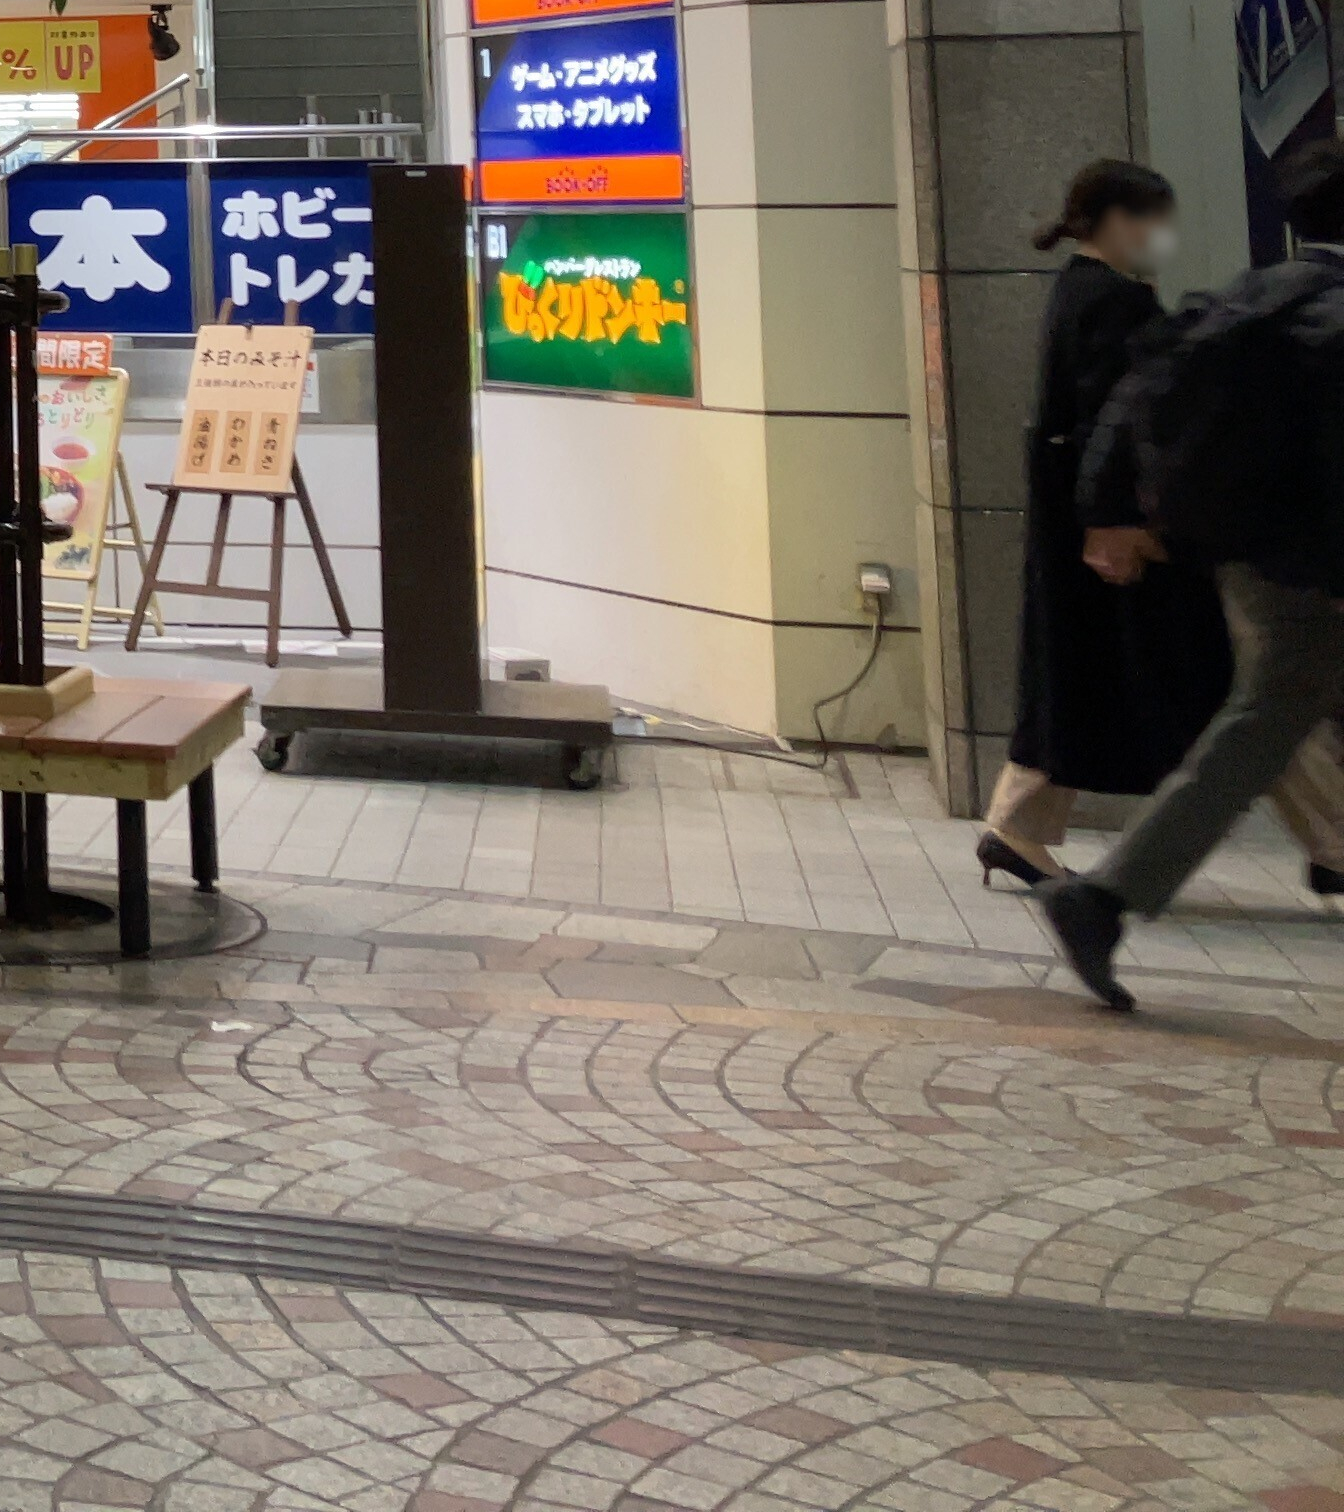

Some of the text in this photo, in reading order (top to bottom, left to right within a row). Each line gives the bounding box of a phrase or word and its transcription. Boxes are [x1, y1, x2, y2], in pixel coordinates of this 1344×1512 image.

[479, 47, 493, 79] 1
[221, 187, 373, 240] ホビー
[28, 194, 172, 303] 本
[37, 338, 109, 371] 間限定
